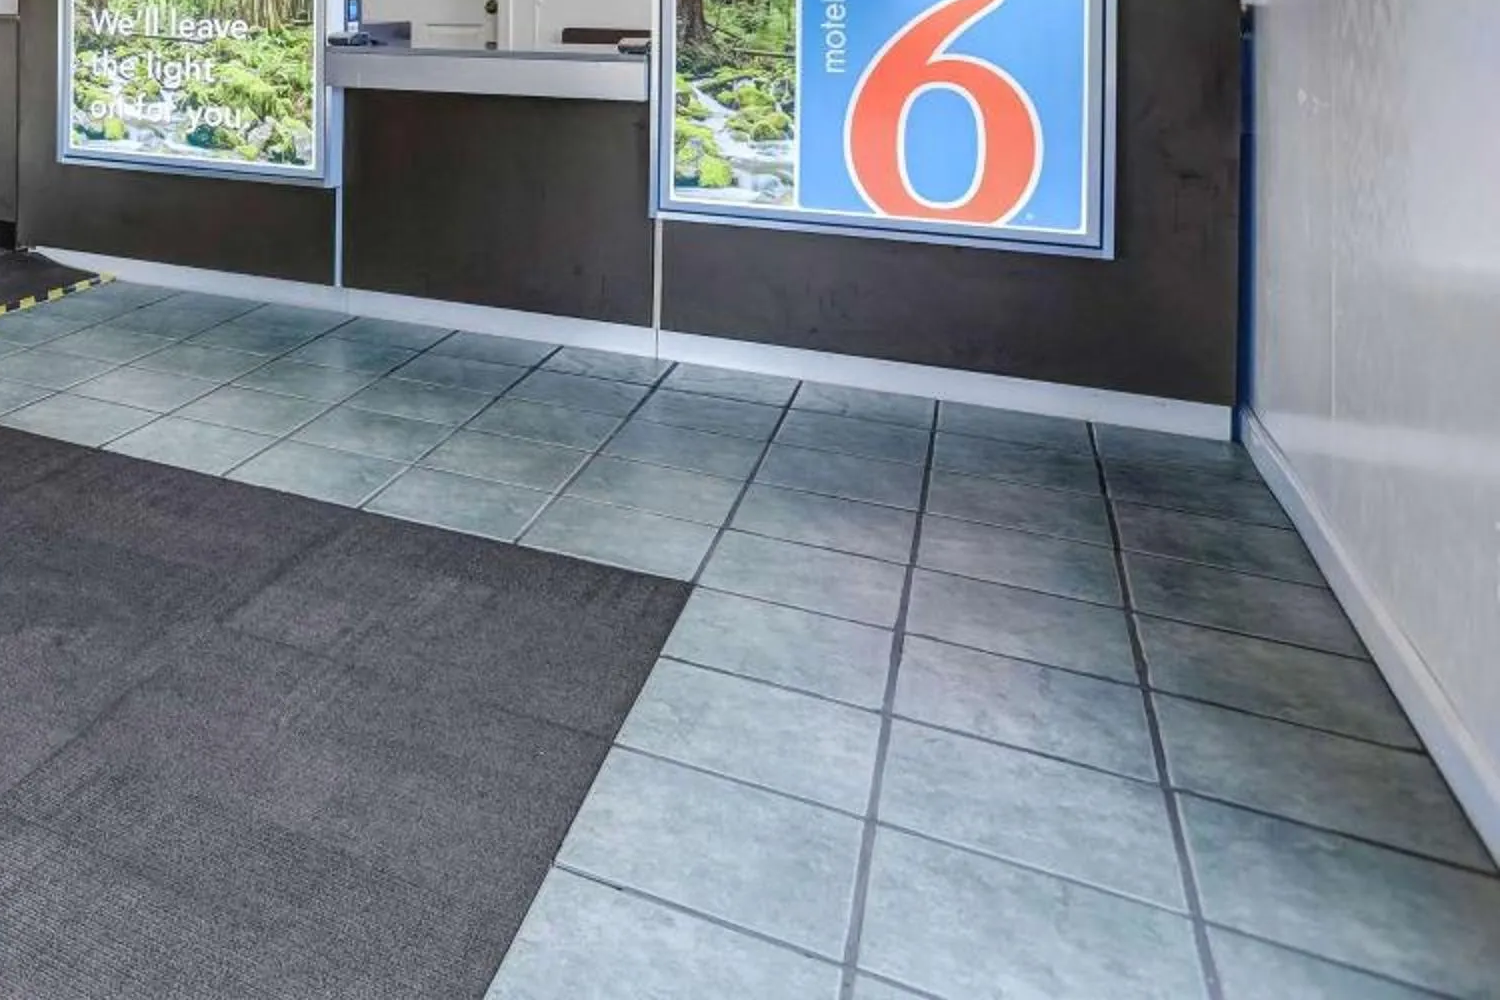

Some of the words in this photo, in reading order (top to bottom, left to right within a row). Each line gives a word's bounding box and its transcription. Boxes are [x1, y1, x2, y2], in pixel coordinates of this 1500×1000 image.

[90, 6, 159, 37] We'll
[171, 6, 249, 41] leave
[92, 49, 138, 79] the
[147, 50, 215, 89] light
[90, 99, 124, 119] on
